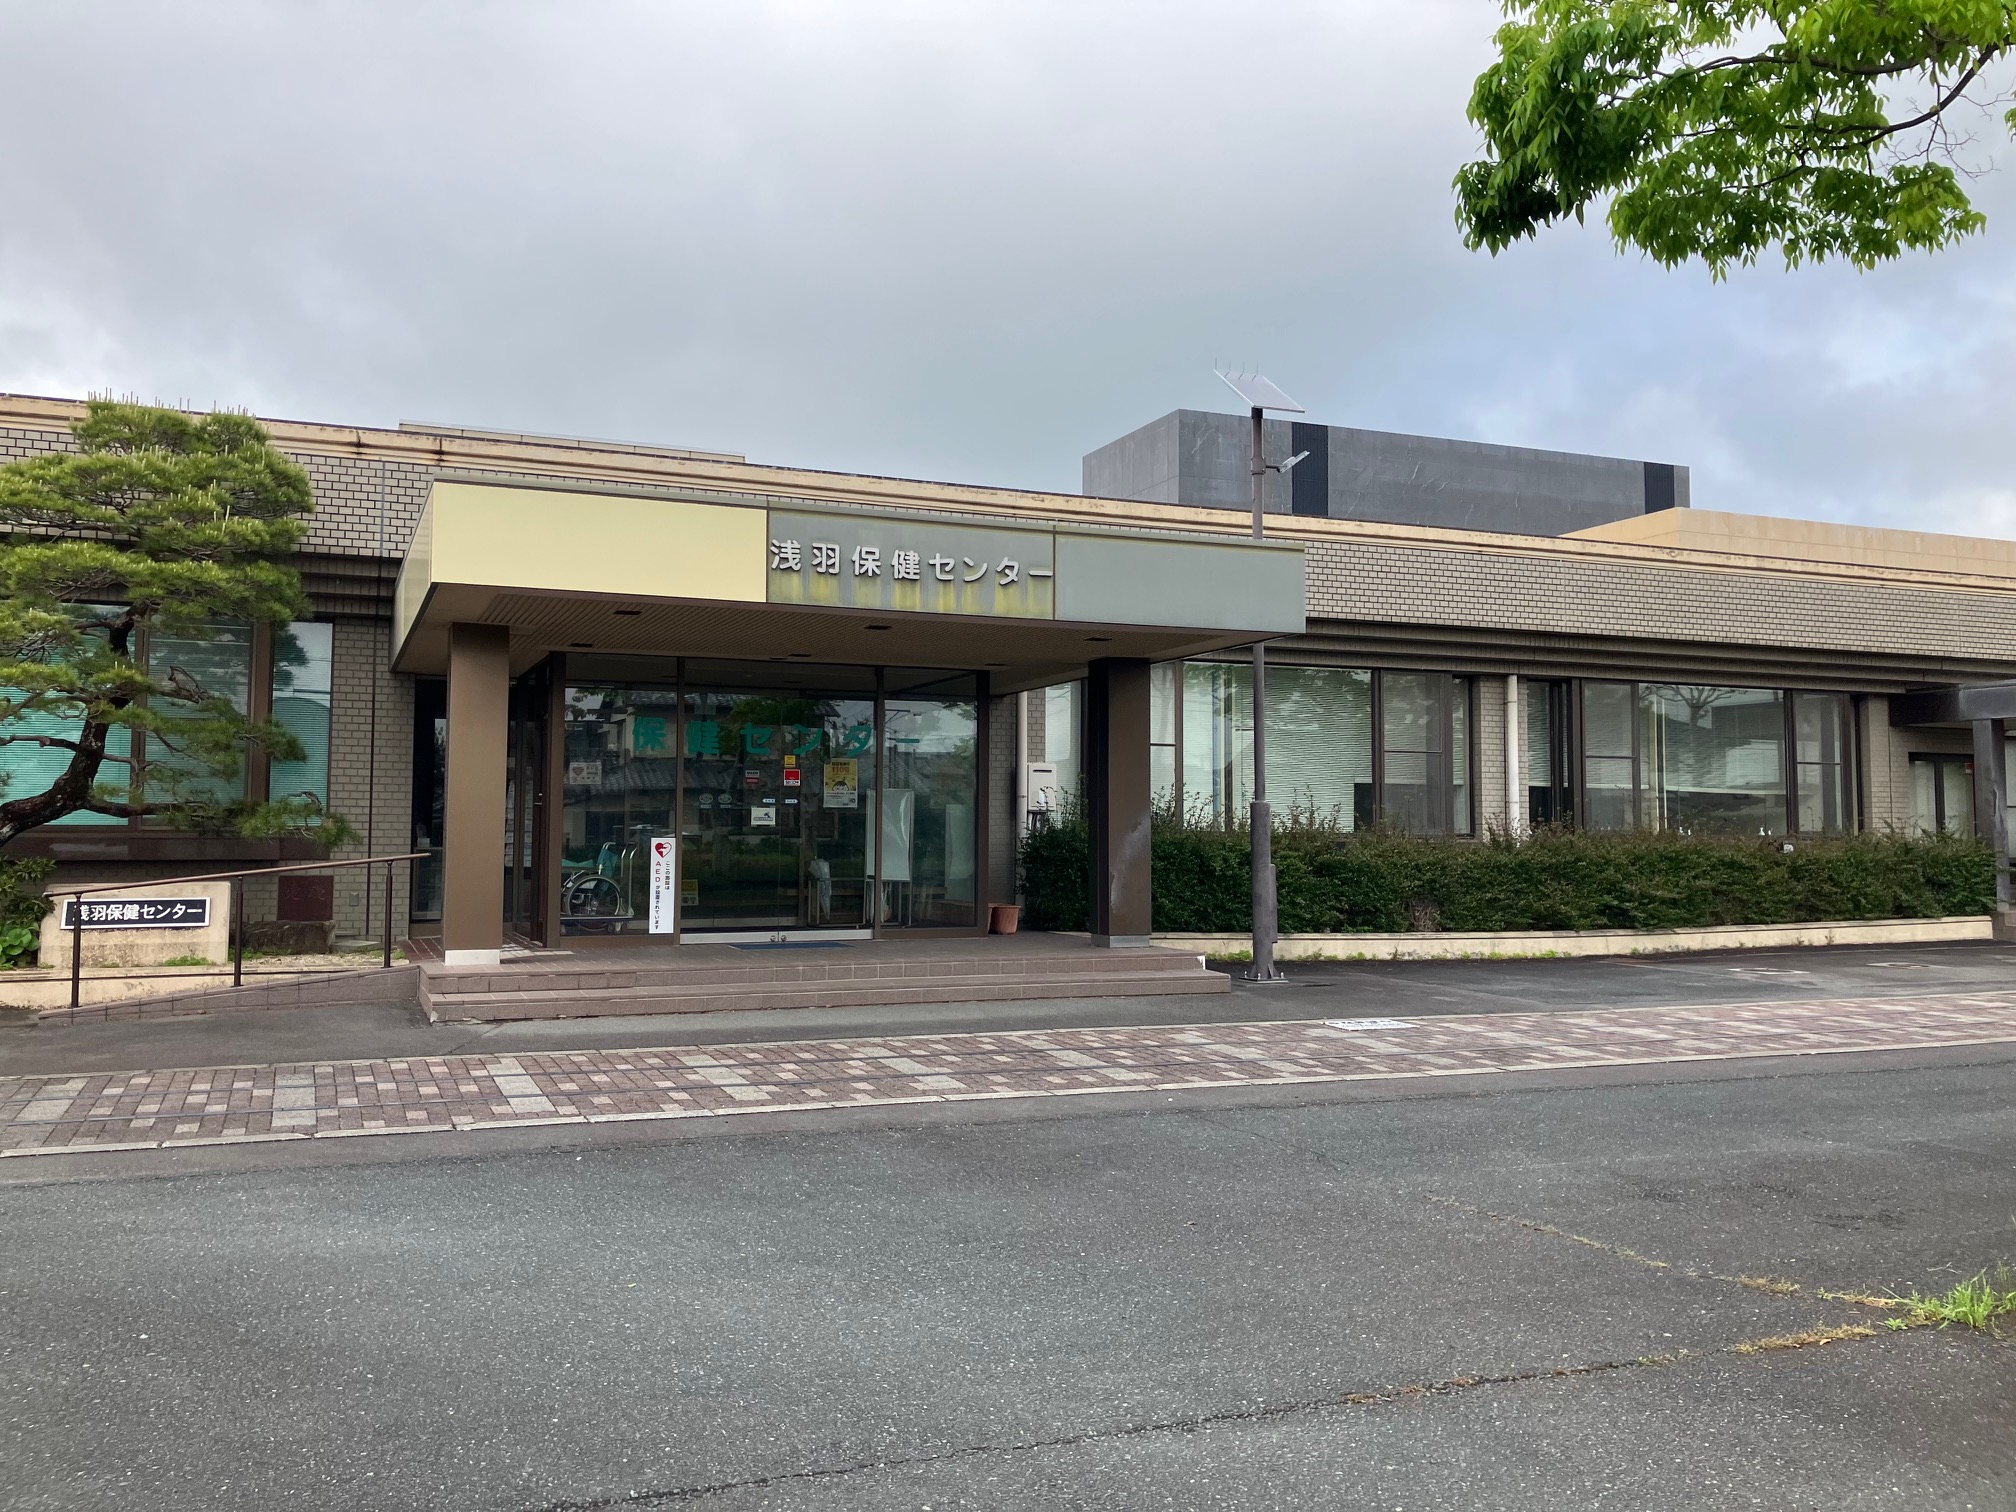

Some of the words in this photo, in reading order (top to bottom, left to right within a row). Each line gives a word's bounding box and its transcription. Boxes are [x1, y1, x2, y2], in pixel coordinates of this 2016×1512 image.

[770, 539, 1053, 585] 浅羽保健センター
[632, 716, 920, 757] 保健センター
